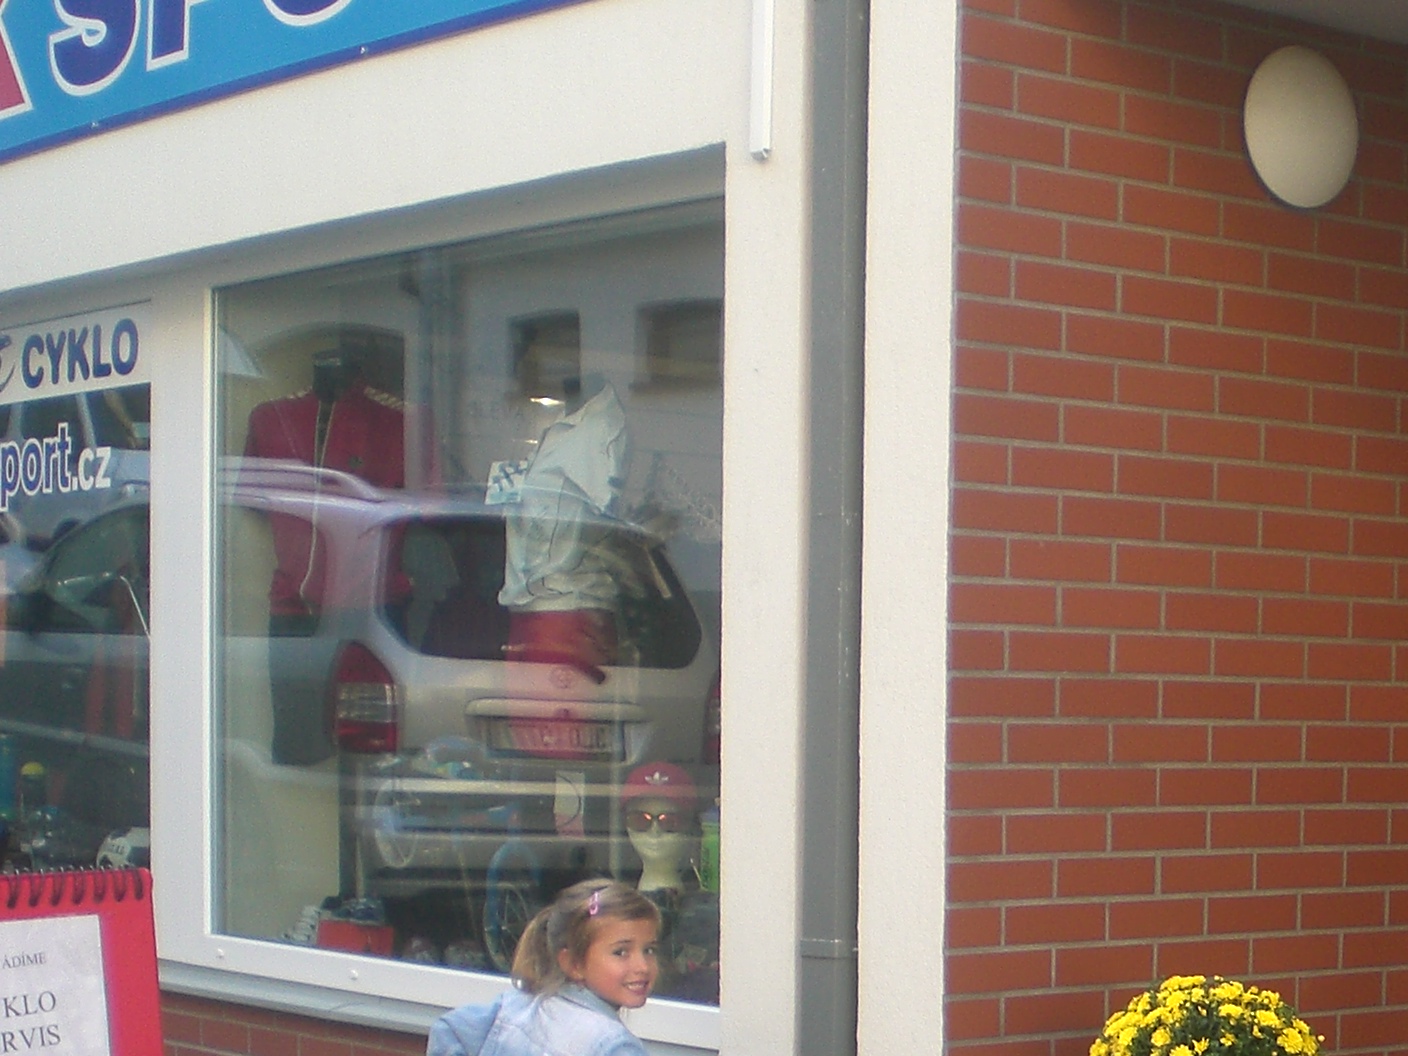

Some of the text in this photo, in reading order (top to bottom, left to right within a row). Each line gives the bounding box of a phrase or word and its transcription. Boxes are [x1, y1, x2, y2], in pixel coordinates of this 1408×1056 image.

[22, 318, 139, 389] CYKLO
[3, 990, 56, 1018] KLO
[1, 1024, 61, 1053] RVIS
